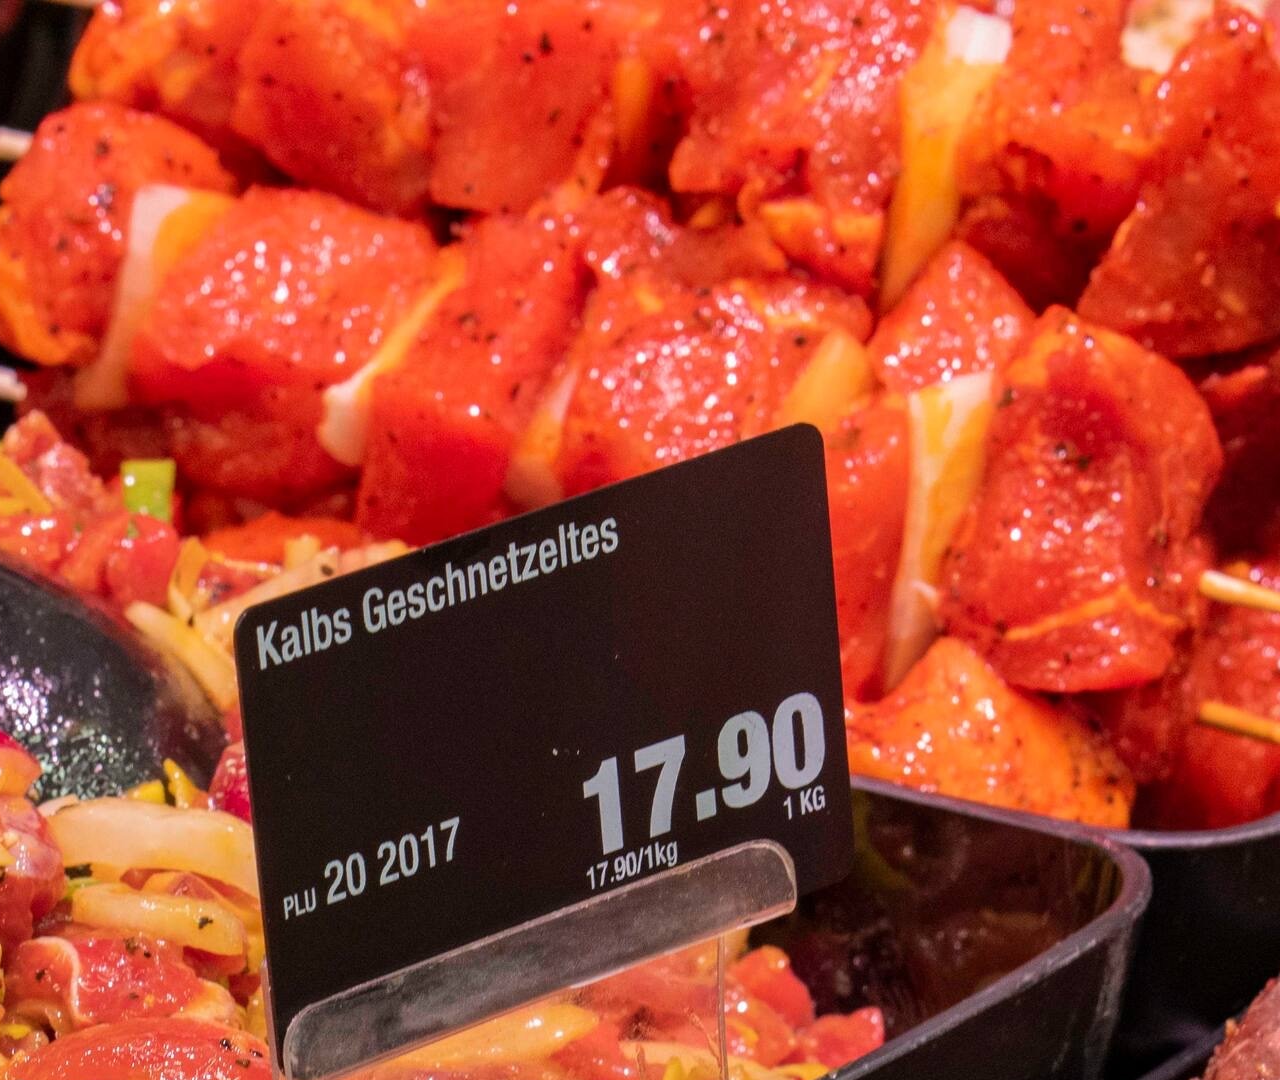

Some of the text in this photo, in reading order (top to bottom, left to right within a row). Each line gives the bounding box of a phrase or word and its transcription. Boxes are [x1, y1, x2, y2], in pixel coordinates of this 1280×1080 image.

[256, 517, 619, 670] Kalbs Geschnetzeltes
[582, 691, 826, 856] 17.90
[783, 785, 826, 821] 1 KG
[283, 817, 461, 921] PLU 20 2017
[586, 840, 679, 890] 17.90/1kg
